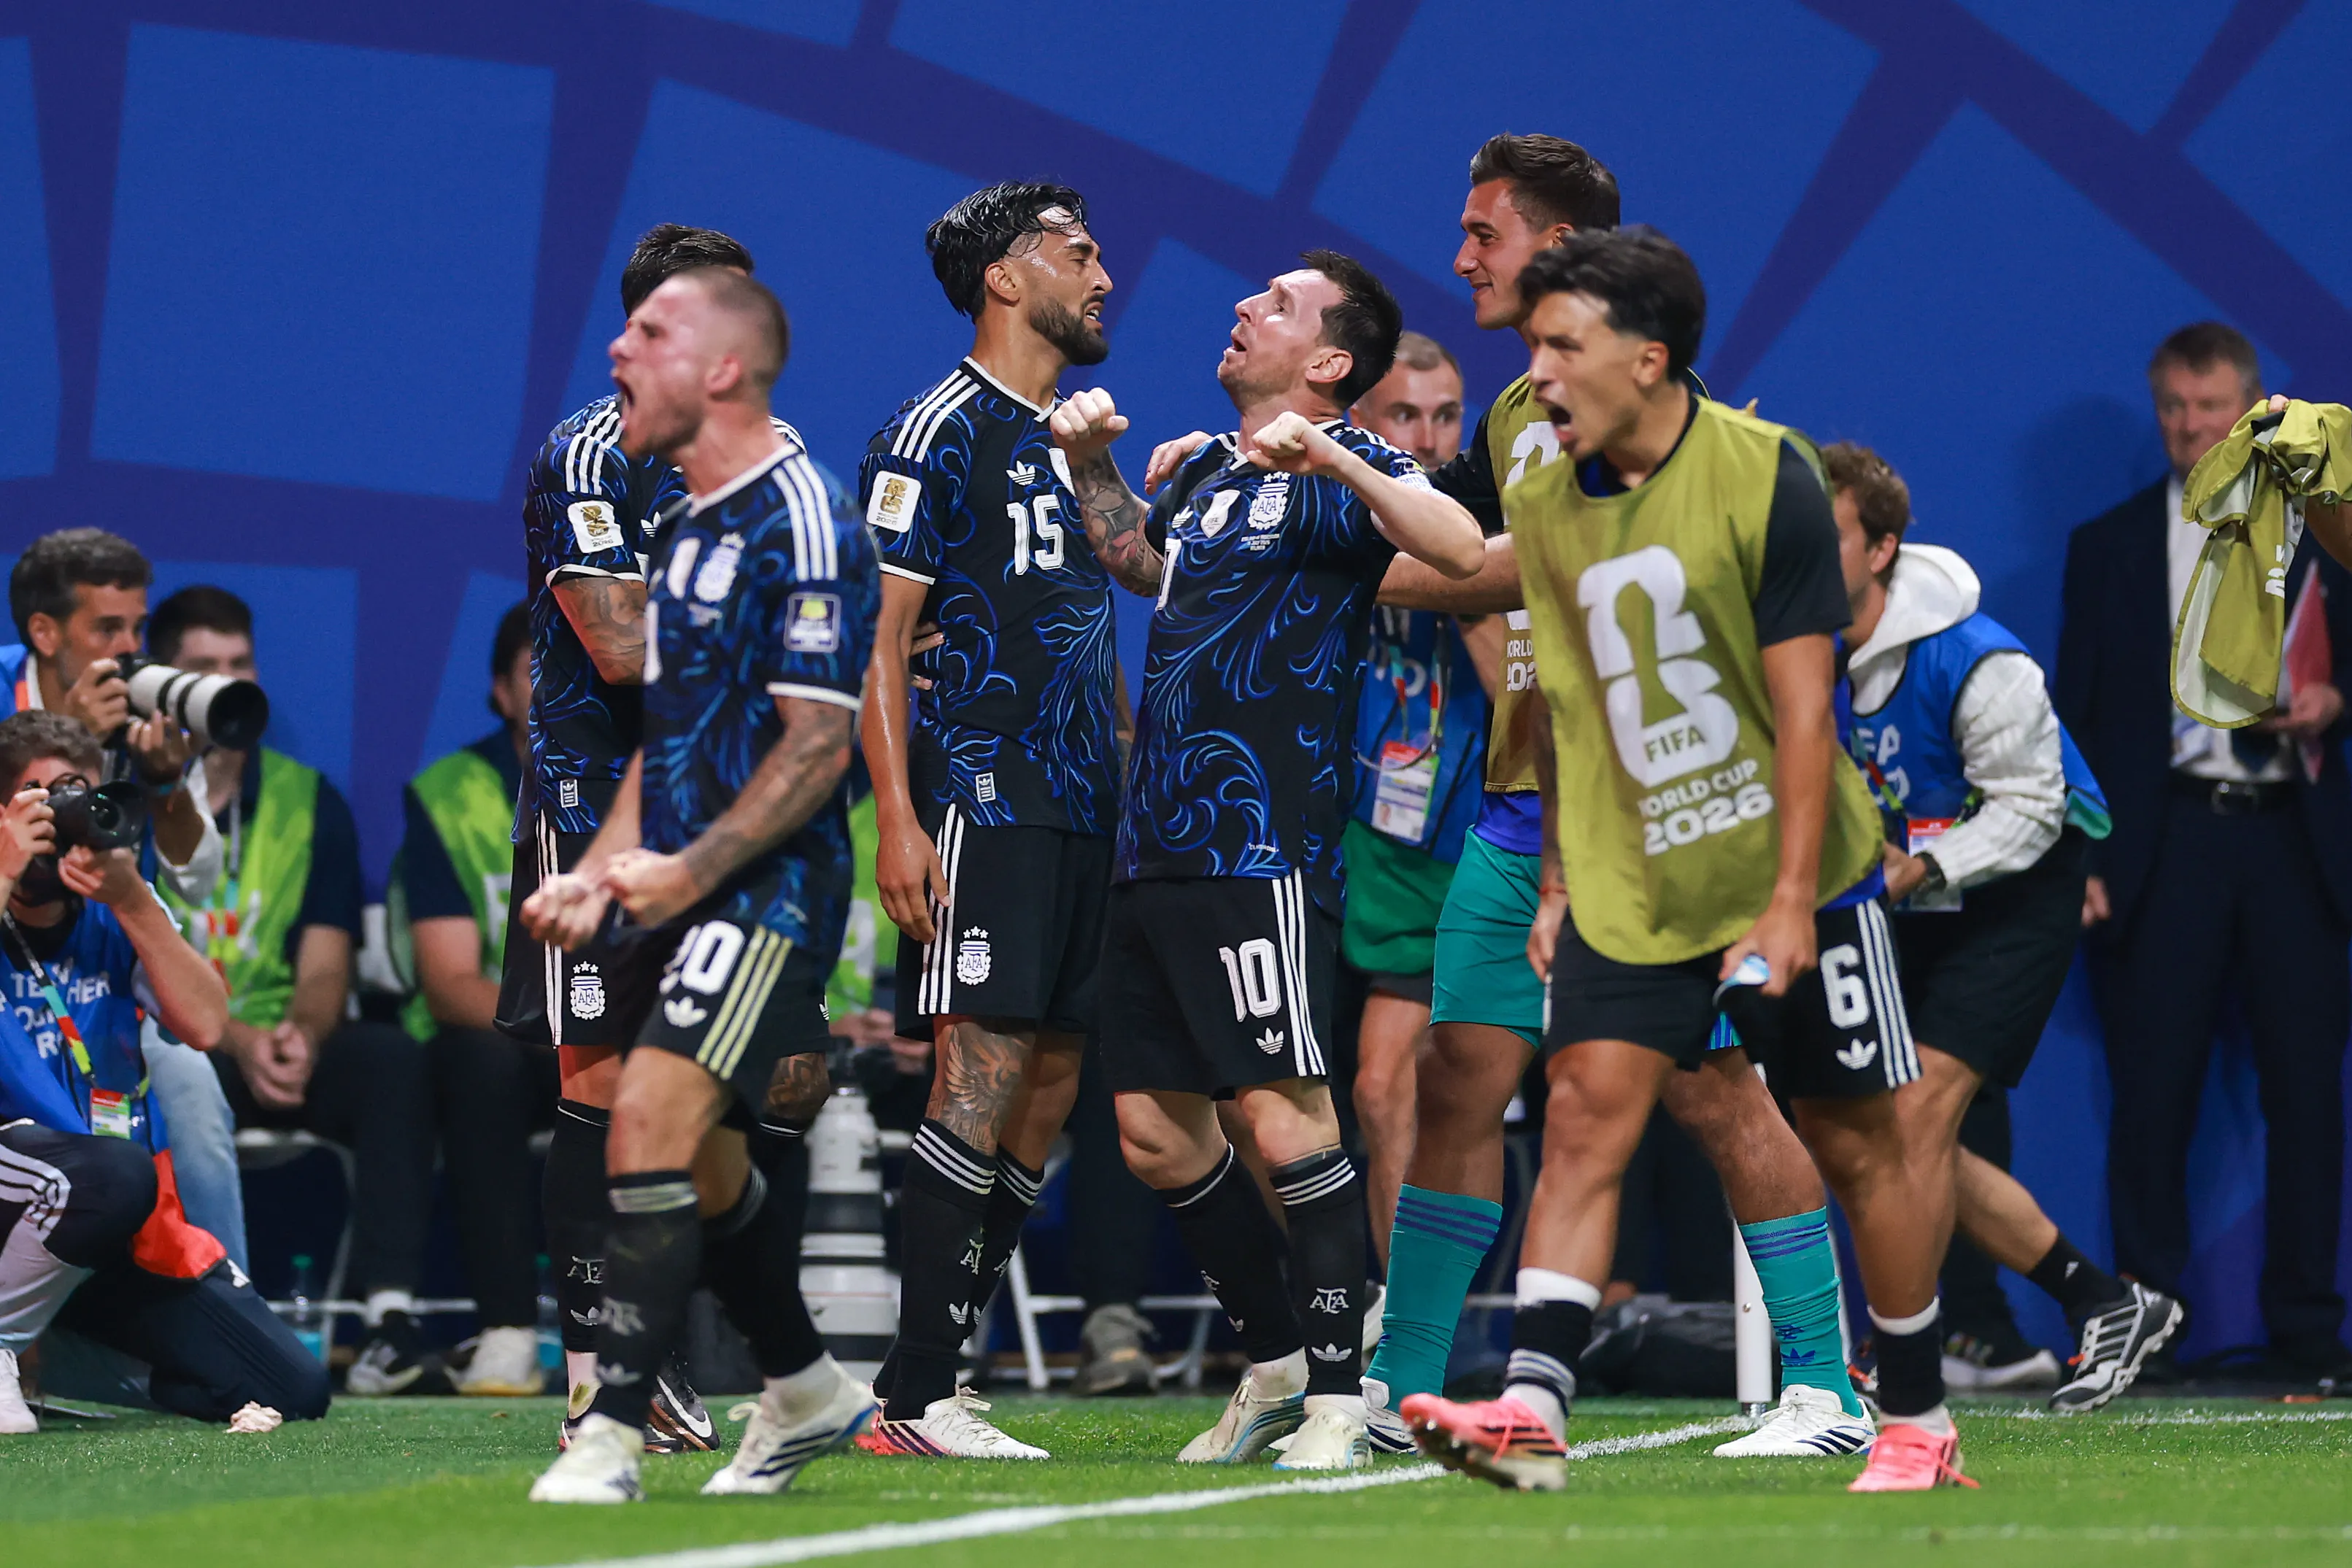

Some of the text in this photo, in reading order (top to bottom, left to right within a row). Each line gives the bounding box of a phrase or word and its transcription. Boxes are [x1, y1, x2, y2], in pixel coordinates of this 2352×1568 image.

[1006, 494, 1065, 575] 15
[1507, 639, 1532, 658] ORLD
[1644, 725, 1706, 762] FIFA
[1711, 757, 1758, 792] CUP
[1644, 782, 1774, 857] 2026
[578, 987, 597, 1006] AFA
[1219, 938, 1281, 1022] 10
[1820, 943, 1870, 1030] 6
[1309, 1288, 1350, 1314] AFA
